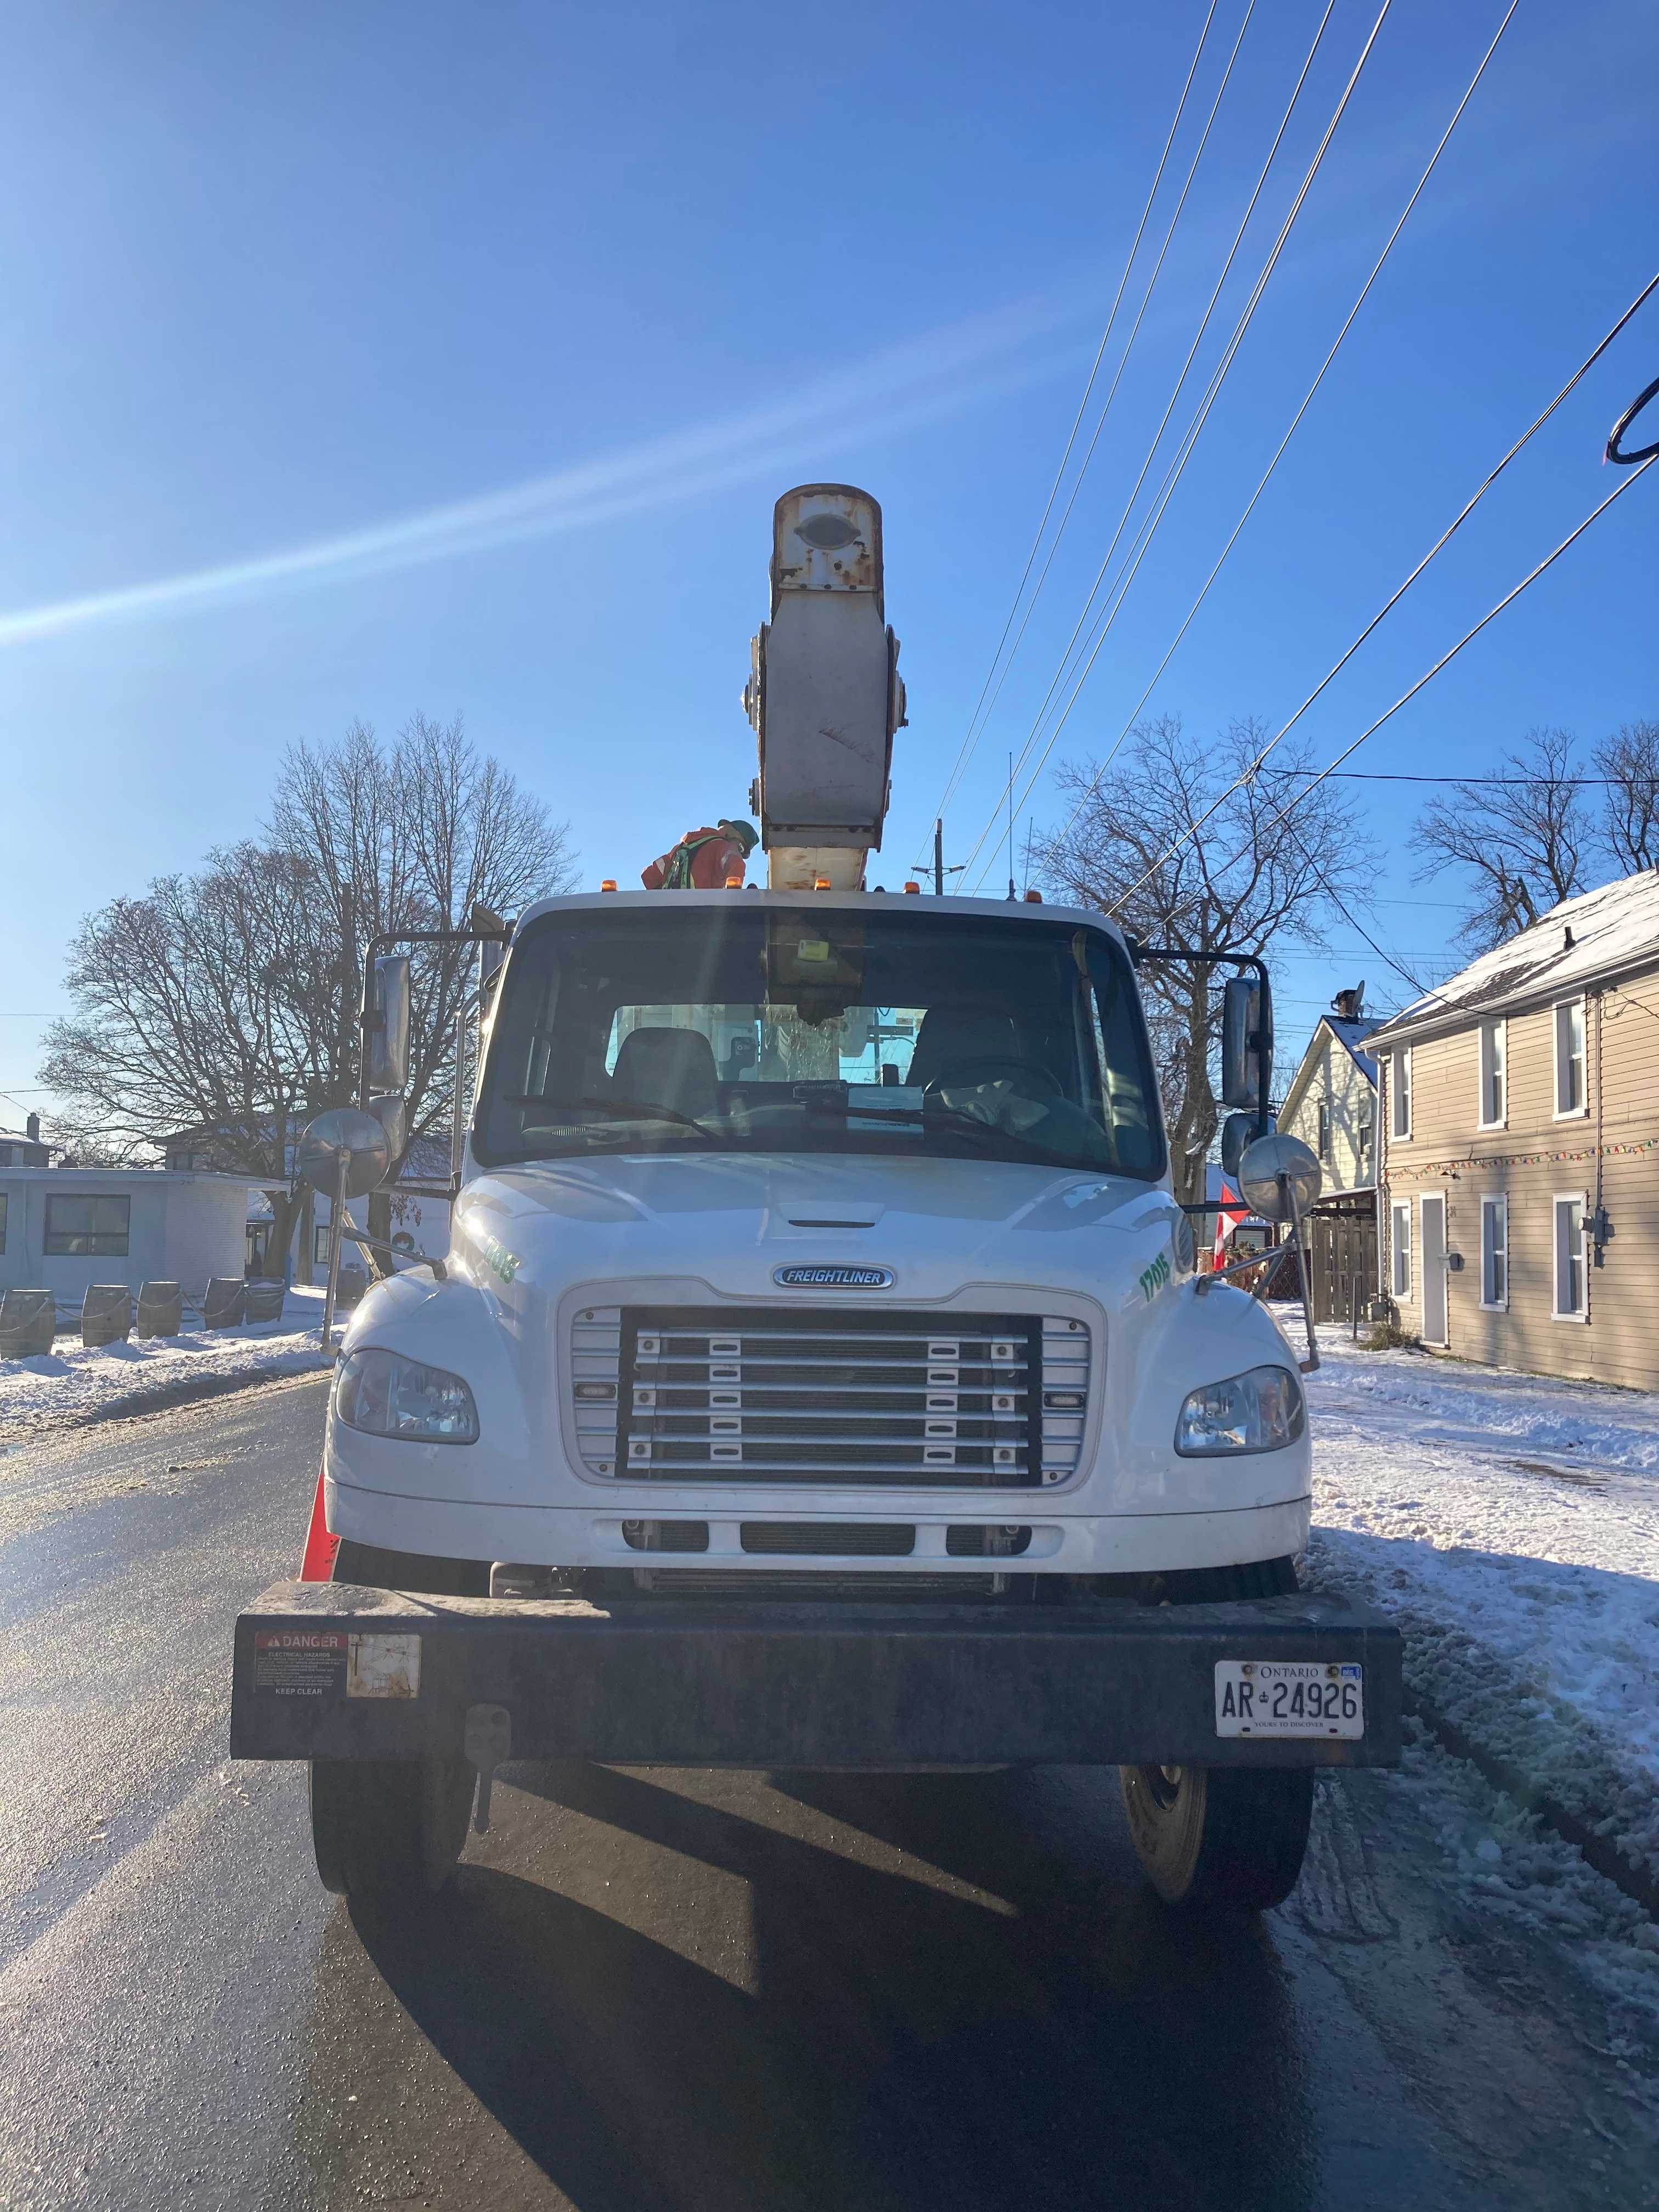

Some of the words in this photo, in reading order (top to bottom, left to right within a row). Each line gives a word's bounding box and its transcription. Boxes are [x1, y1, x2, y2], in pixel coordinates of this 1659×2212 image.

[787, 1269, 881, 1283] FREIGHTLINER
[283, 1635, 338, 1647] DANGER
[1260, 1666, 1319, 1679] ONTARIO
